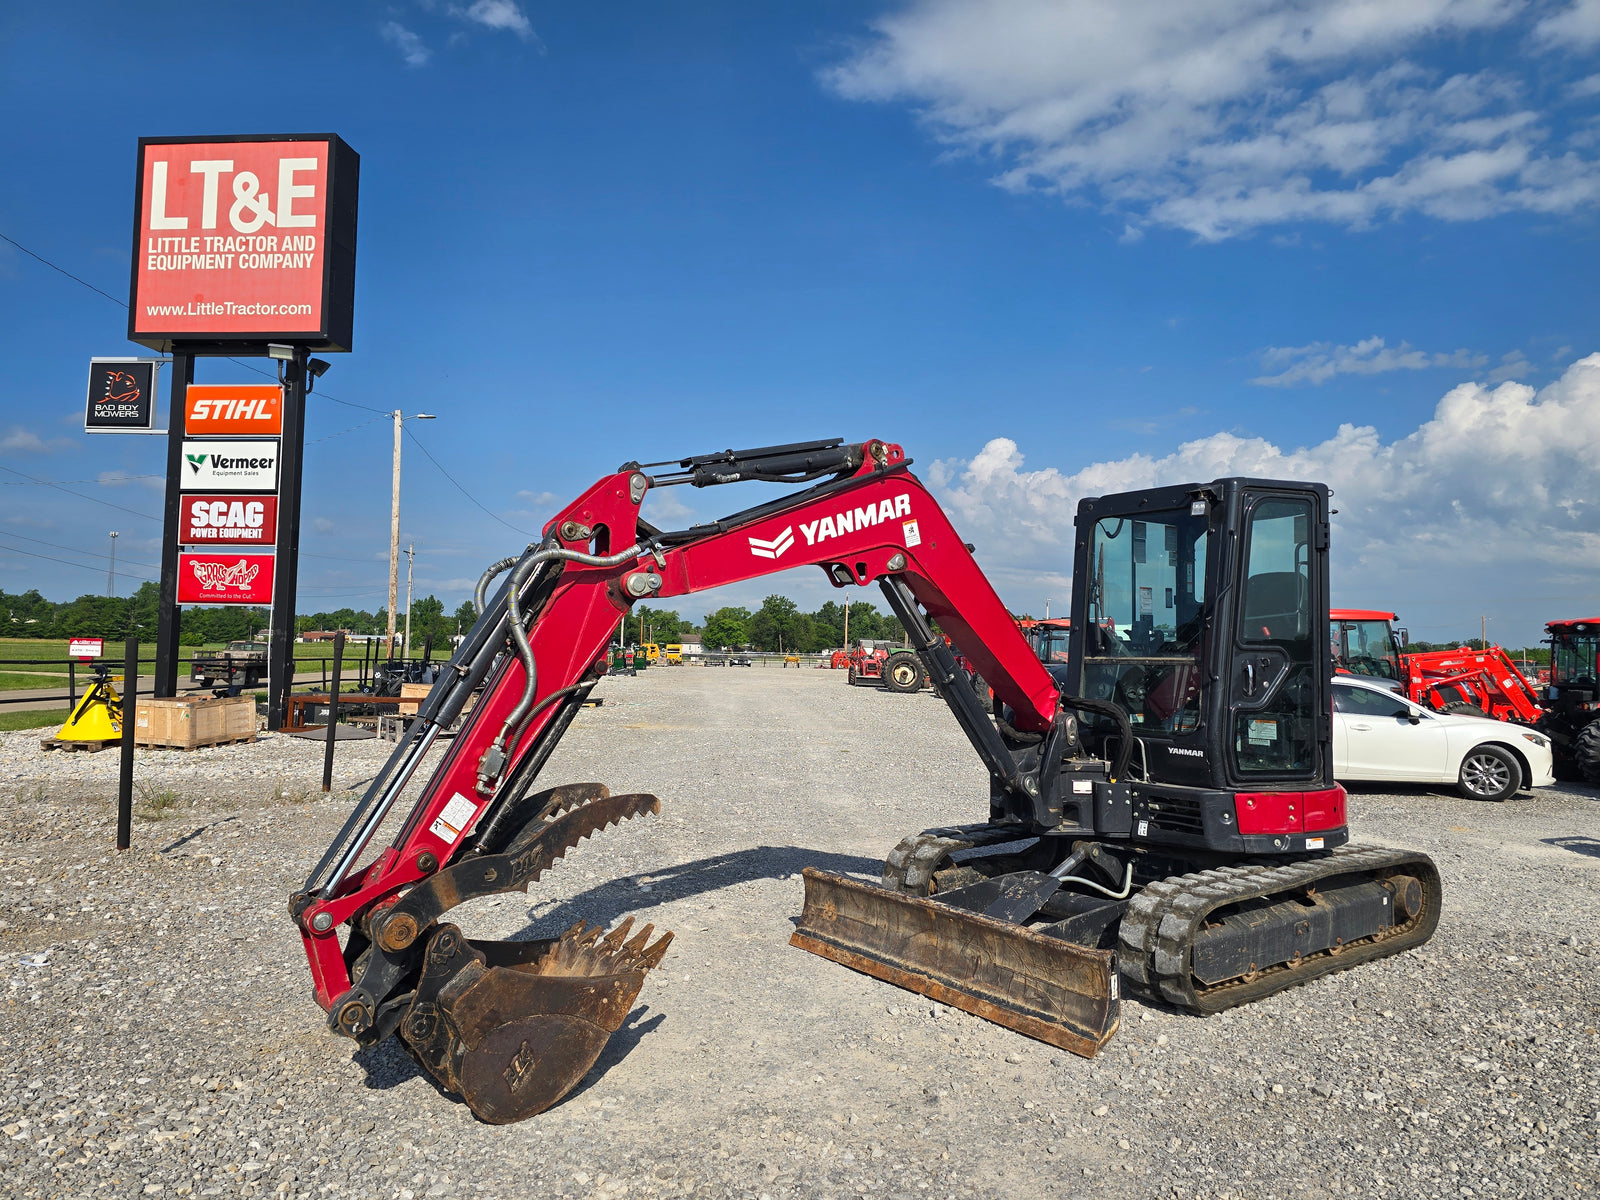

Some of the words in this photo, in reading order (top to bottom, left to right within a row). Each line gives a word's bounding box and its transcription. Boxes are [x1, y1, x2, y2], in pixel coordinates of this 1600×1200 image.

[150, 157, 318, 234] LT&E
[148, 237, 200, 254] LITTLE
[204, 236, 278, 252] TRACTOR
[281, 235, 316, 252] AND
[147, 254, 234, 271] EQUIPMENT
[238, 253, 315, 270] COMPANY
[147, 302, 312, 316] www.LittleTractor.com
[94, 410, 139, 418] MOWERS
[190, 399, 273, 420] STIHL
[210, 454, 275, 469] Vermeer
[190, 501, 264, 528] SCAG
[798, 493, 912, 546] YANMAR
[190, 528, 218, 538] POWER
[219, 528, 263, 539] EQUIPMENT
[1167, 746, 1204, 757] YANMAR
